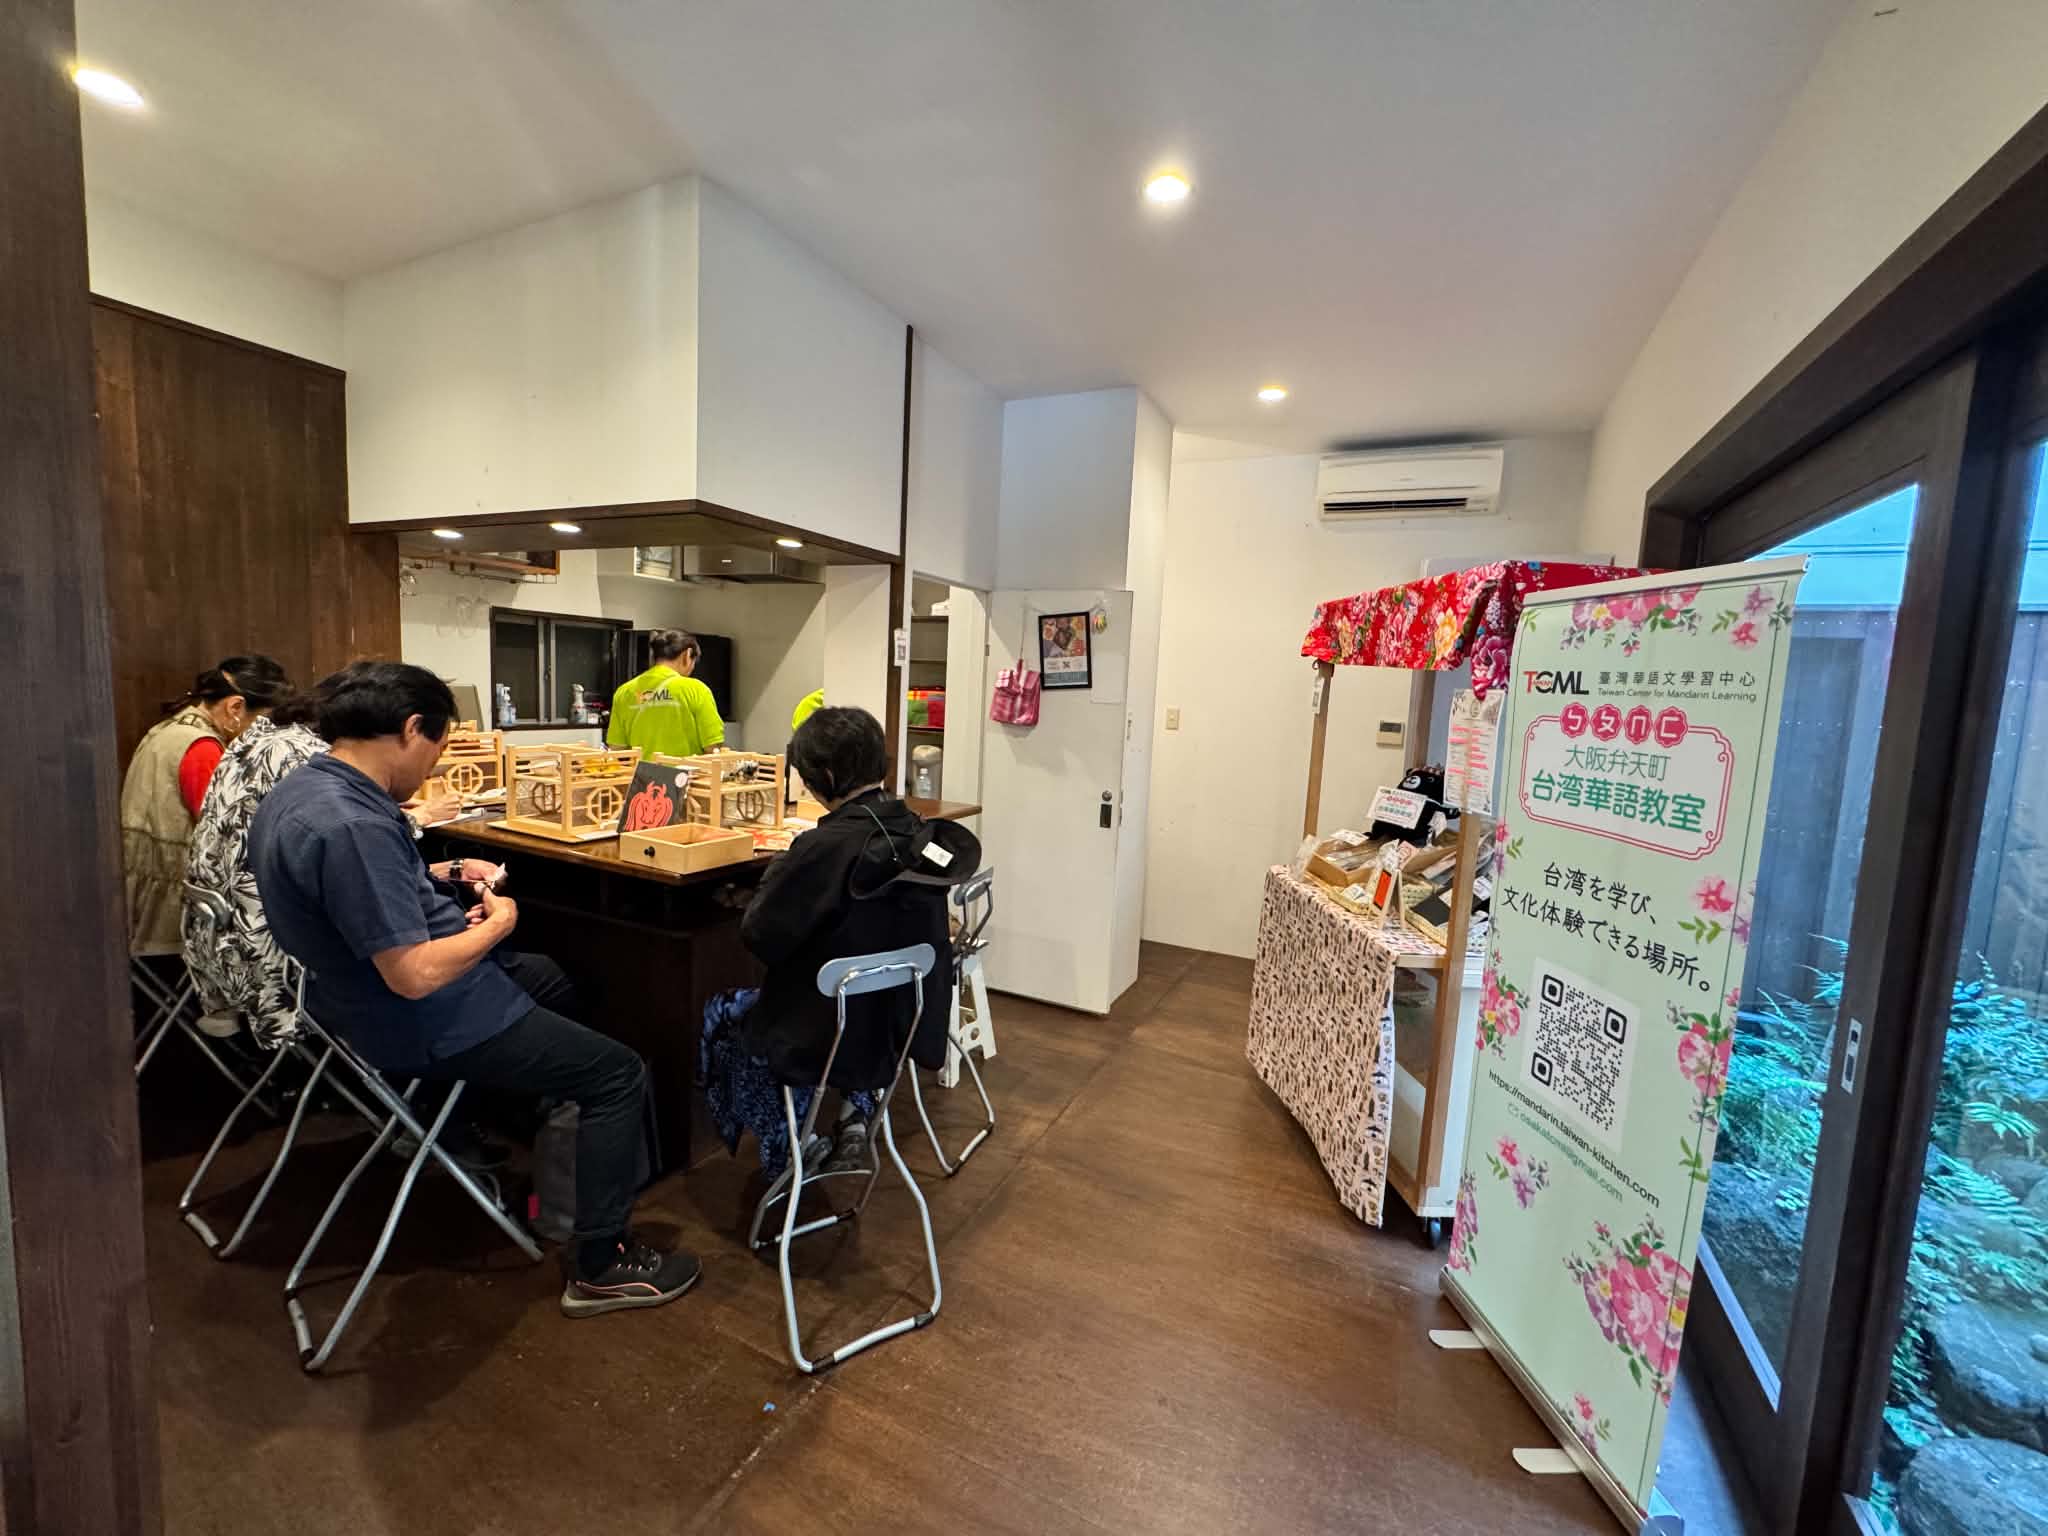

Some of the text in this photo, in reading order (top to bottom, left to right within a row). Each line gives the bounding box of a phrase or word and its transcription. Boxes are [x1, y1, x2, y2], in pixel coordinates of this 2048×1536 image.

[1523, 670, 1590, 696] TCML
[1711, 690, 1757, 704] Learning
[1563, 743, 1673, 782] 大阪弁天町
[1531, 768, 1706, 834] 台湾華語教室
[1542, 861, 1658, 926] 台湾を学び、
[1501, 884, 1712, 993] 文化体験できる場所。
[1489, 1068, 1660, 1209] https://mandarin.taiwan-kitchen.com
